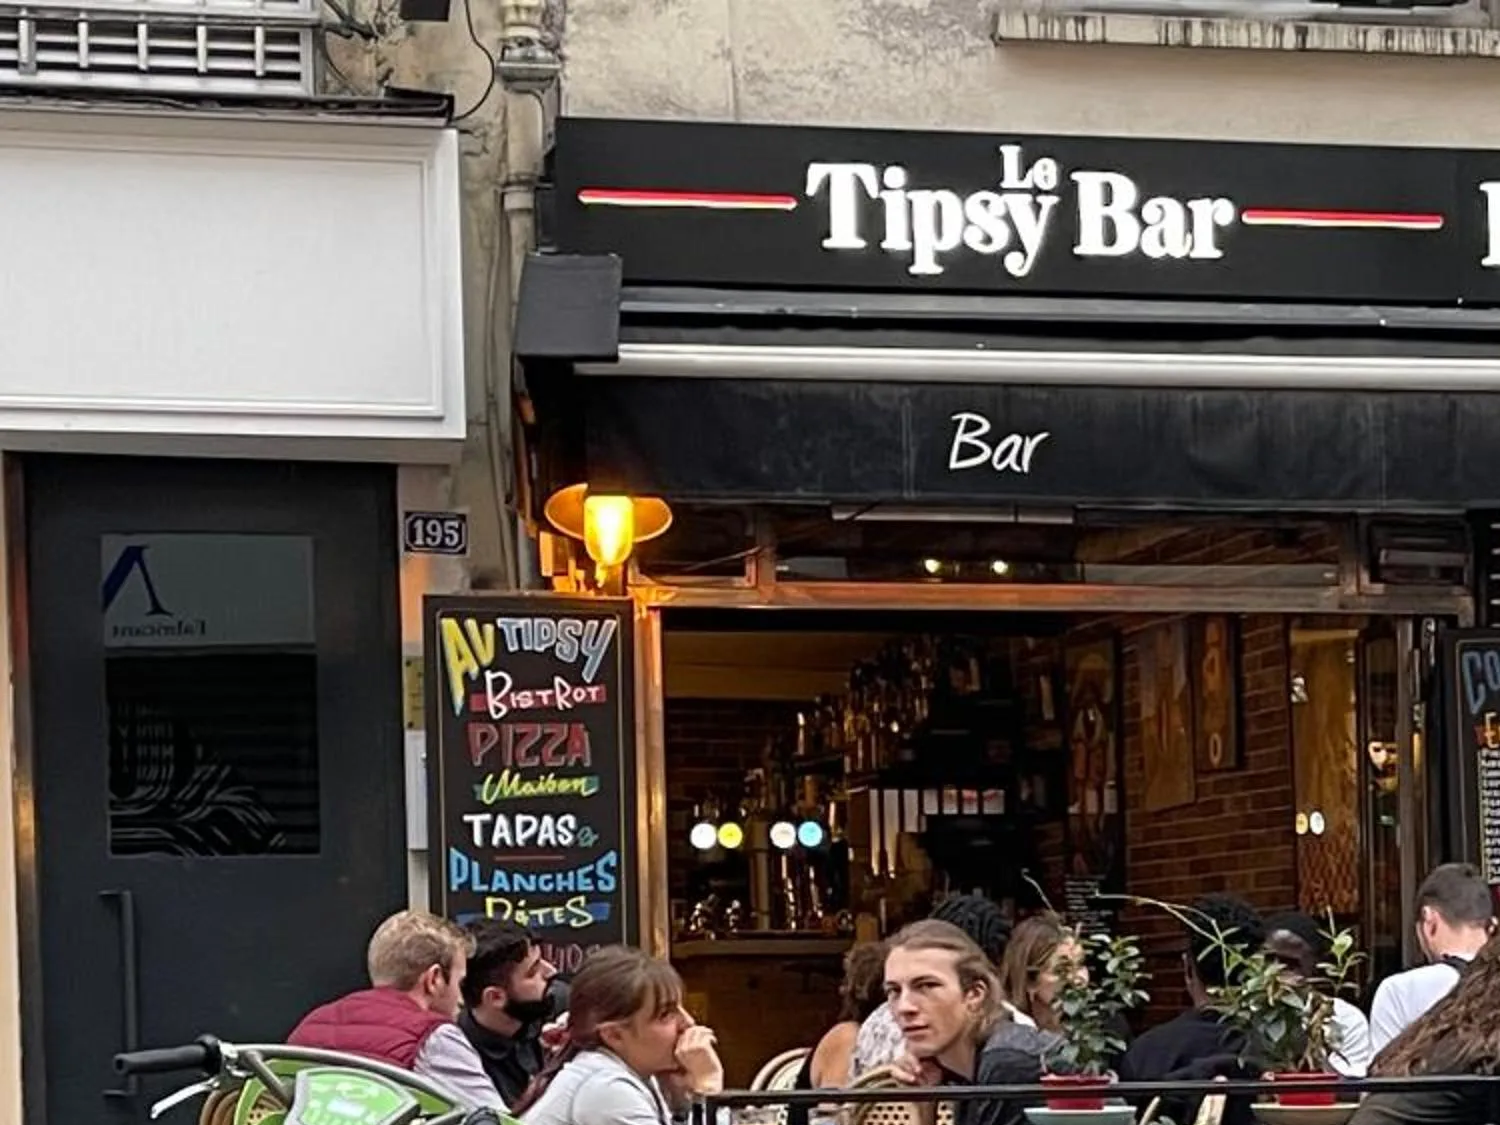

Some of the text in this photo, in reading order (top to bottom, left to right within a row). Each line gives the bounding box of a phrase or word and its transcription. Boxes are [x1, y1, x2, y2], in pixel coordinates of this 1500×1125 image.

[1000, 145, 1056, 190] Le
[806, 162, 1235, 277] Tipsy Bar
[949, 412, 1050, 473] Bar
[412, 519, 460, 547] 195
[497, 617, 617, 683] TIPSY
[467, 722, 592, 768] PIZZA
[463, 813, 577, 848] TAPAS
[450, 848, 617, 893] PLANCHES
